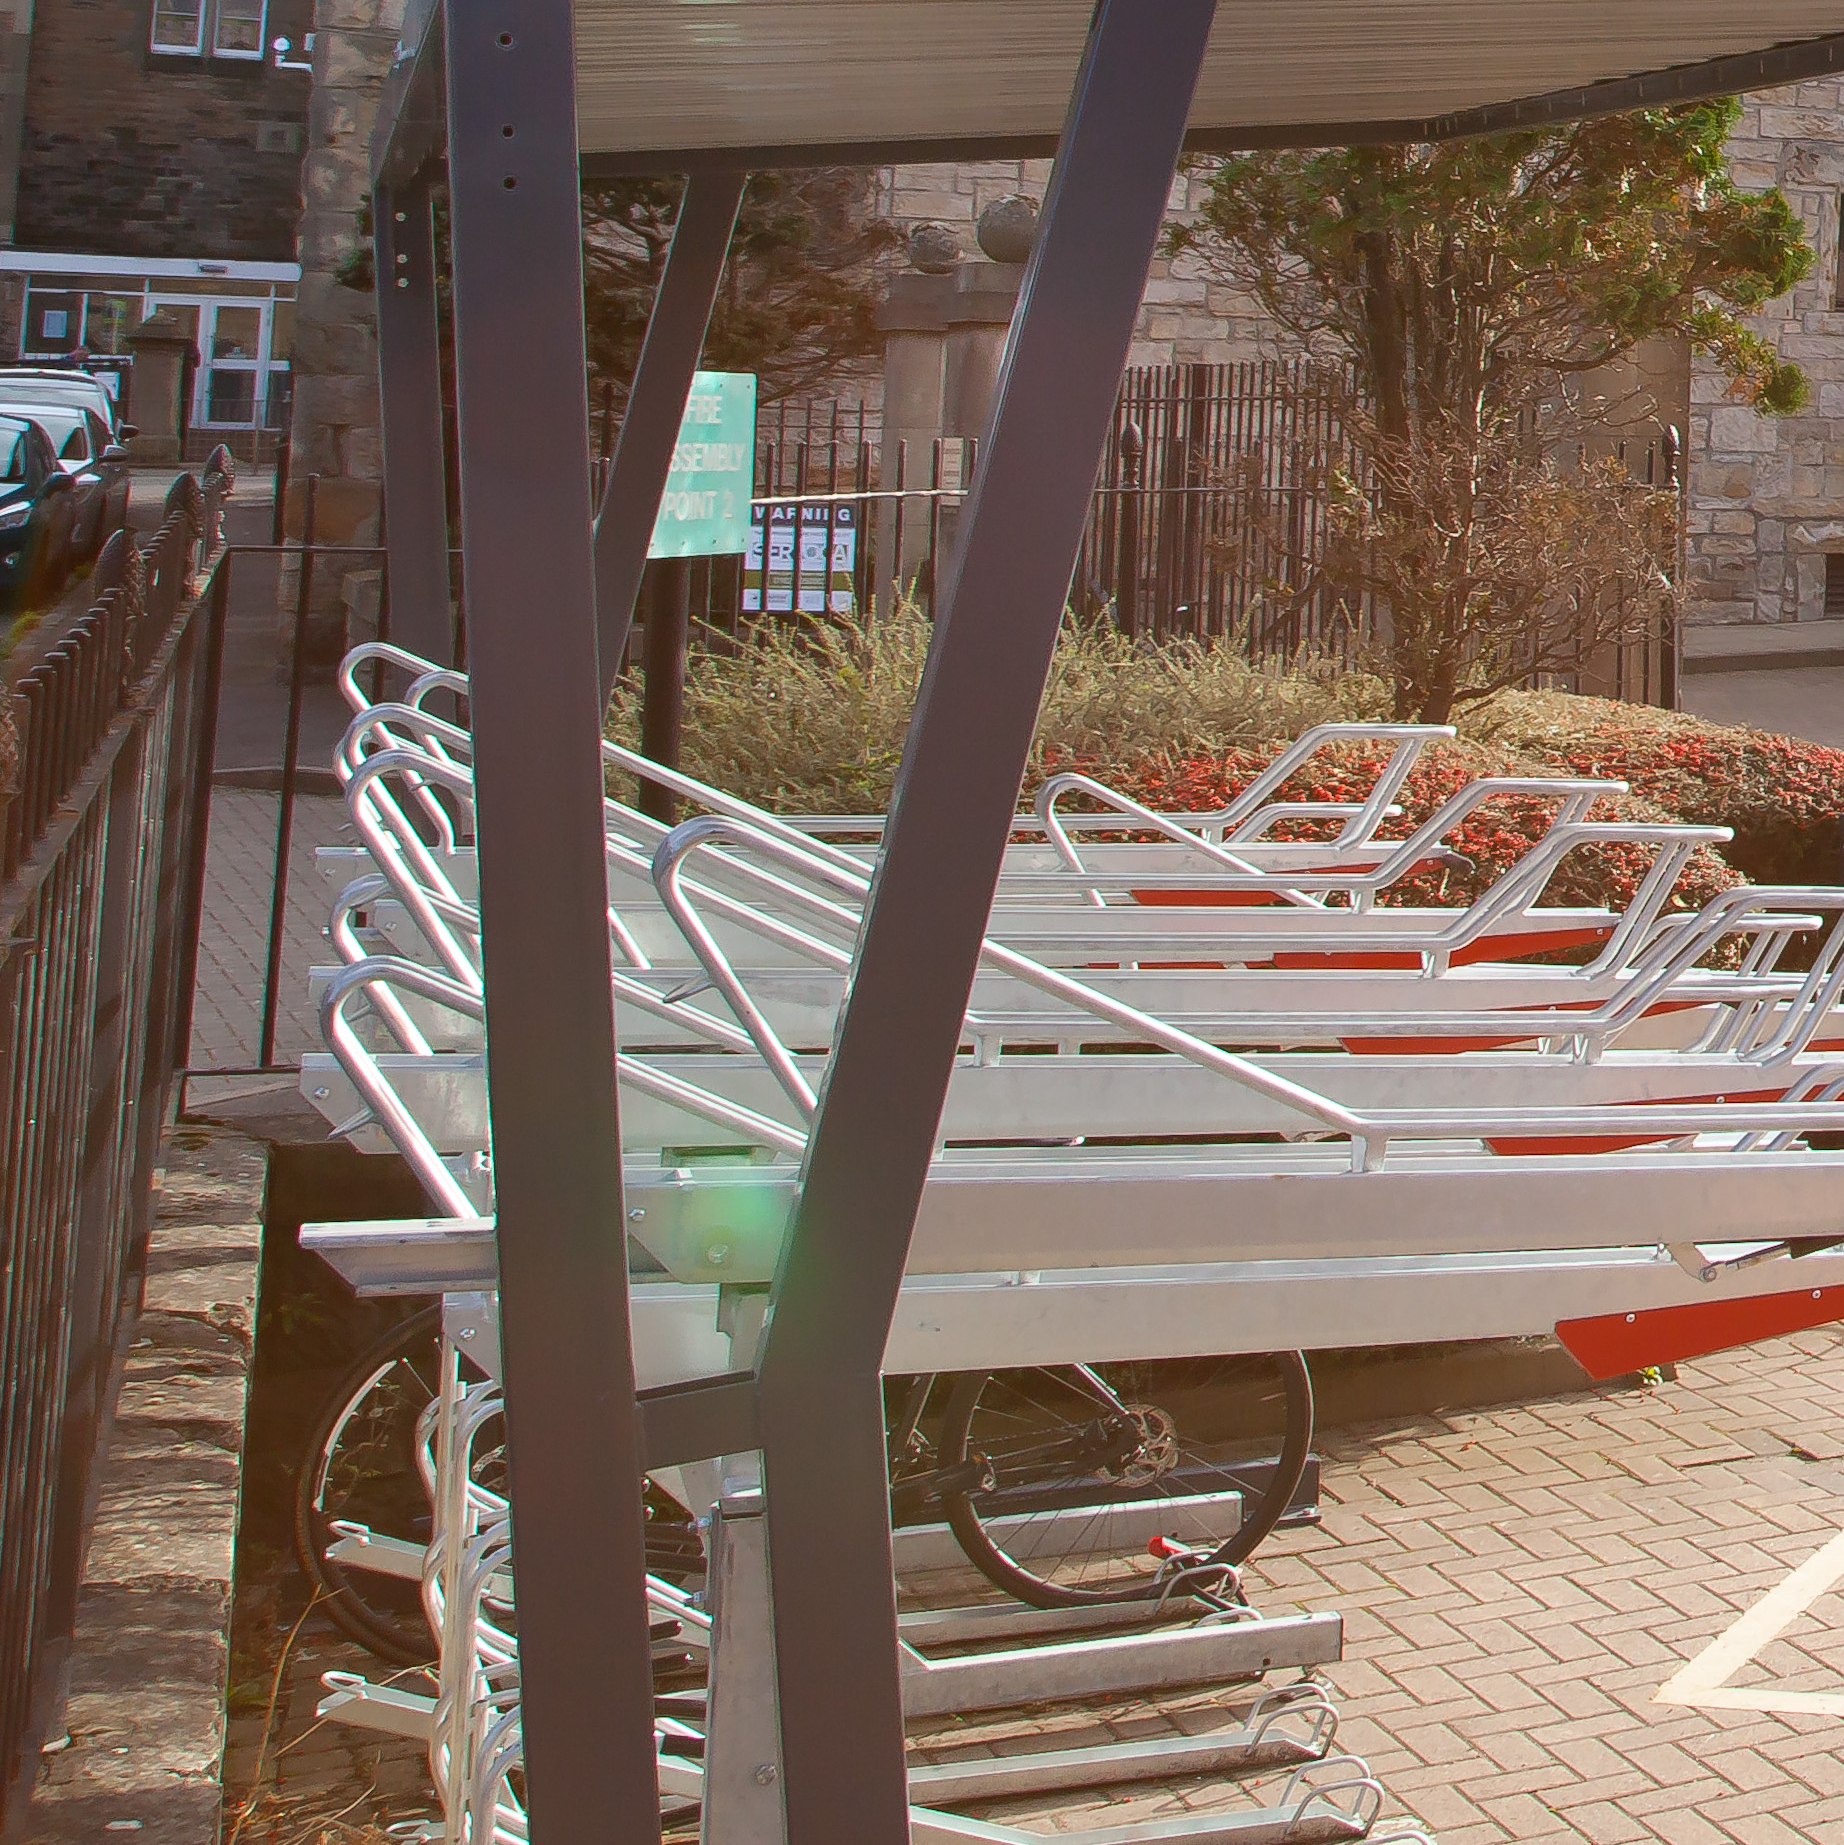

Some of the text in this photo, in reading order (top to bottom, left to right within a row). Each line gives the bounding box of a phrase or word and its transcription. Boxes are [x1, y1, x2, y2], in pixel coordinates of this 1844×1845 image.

[685, 394, 723, 424] FIRE
[670, 443, 745, 472] SSEMBLY
[663, 490, 735, 522] POINT 2
